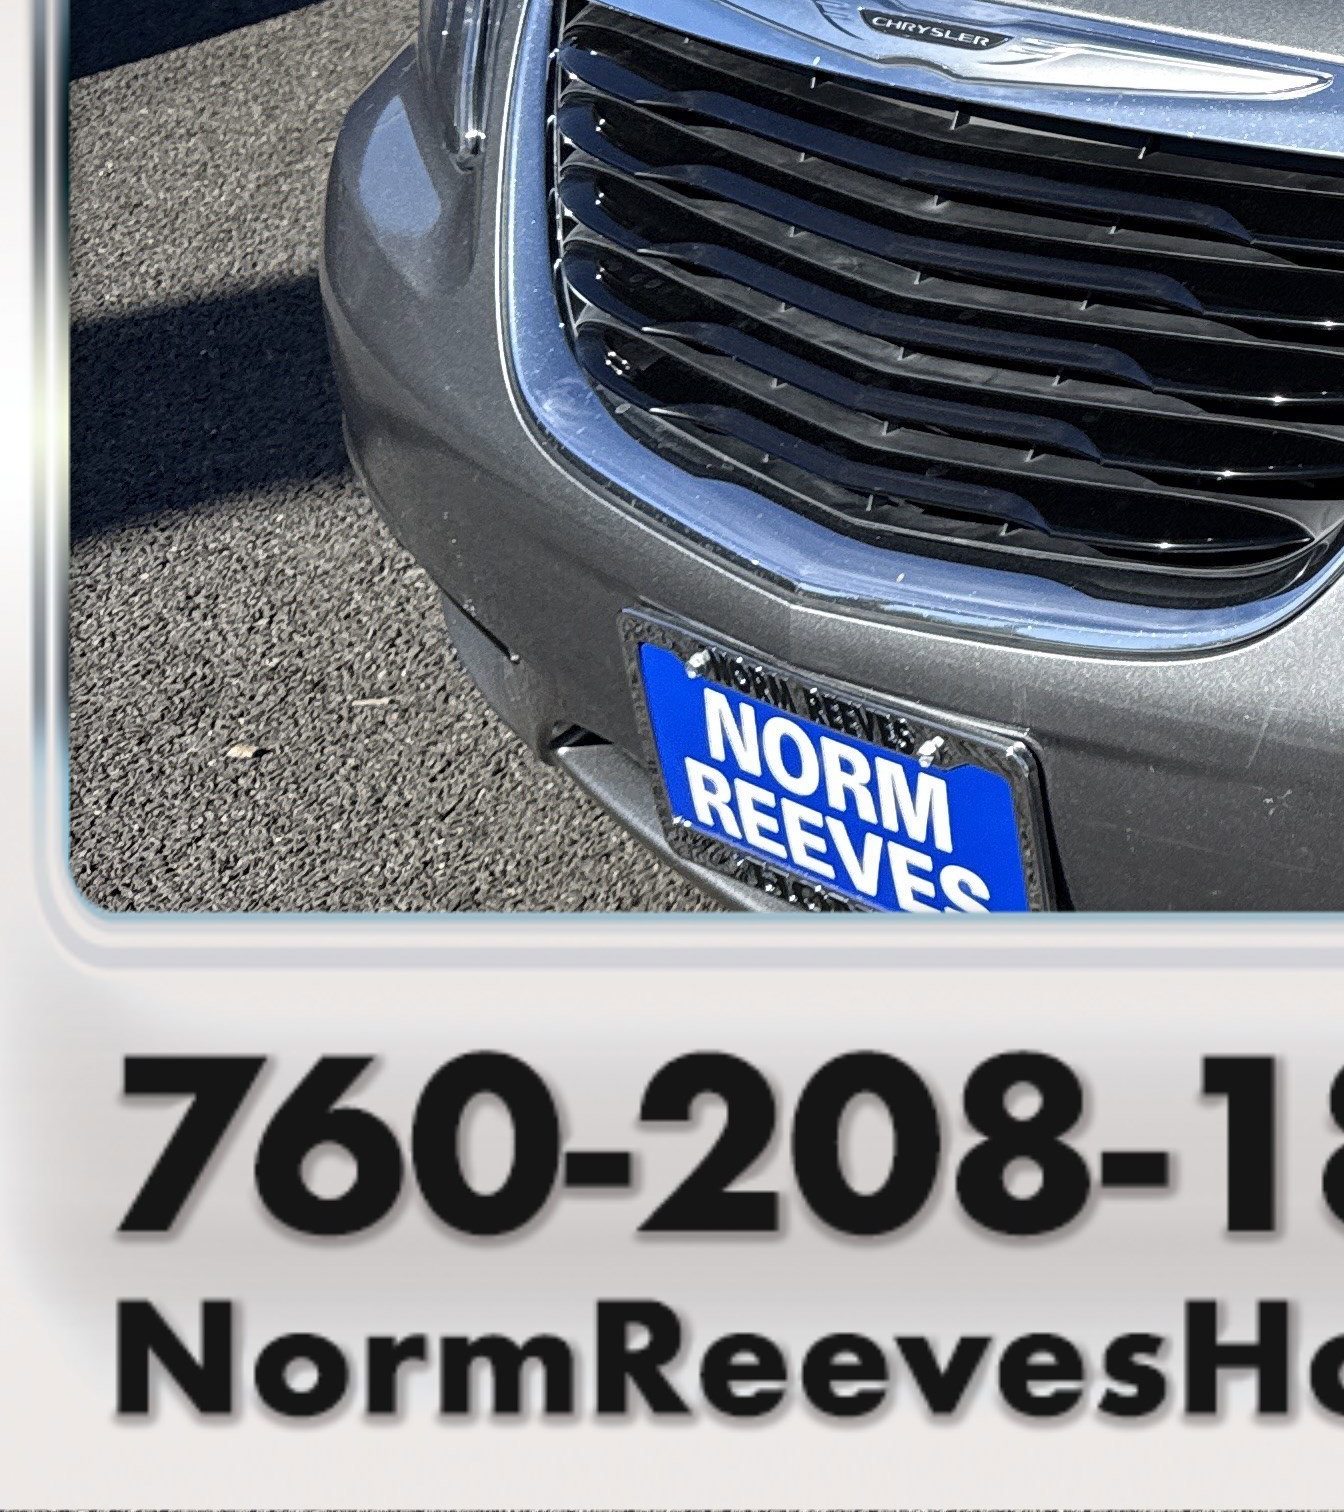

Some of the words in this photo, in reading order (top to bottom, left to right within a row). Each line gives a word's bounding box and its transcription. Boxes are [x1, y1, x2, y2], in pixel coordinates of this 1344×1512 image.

[871, 16, 990, 47] CHRYSLER
[685, 756, 991, 912] REEVES
[703, 687, 954, 854] NORM
